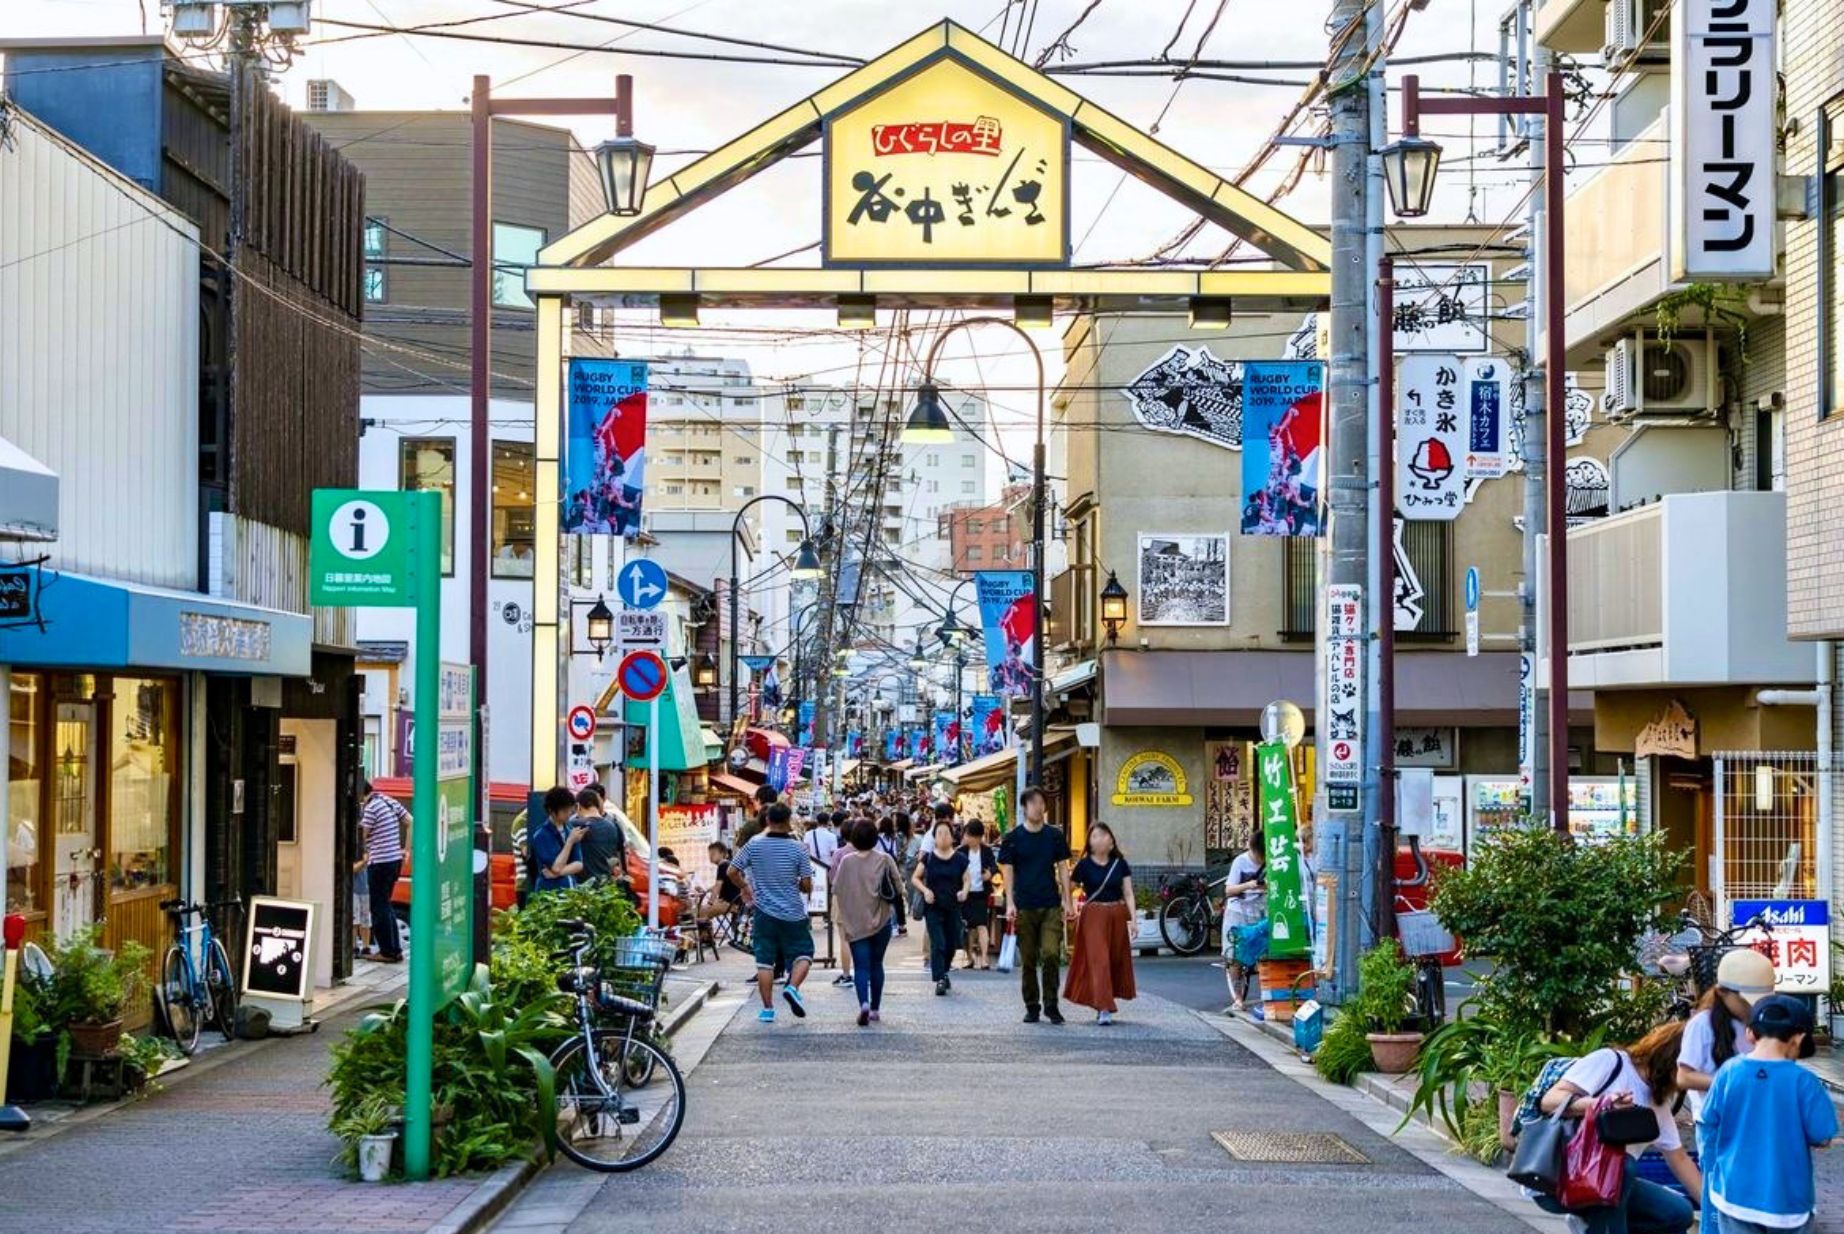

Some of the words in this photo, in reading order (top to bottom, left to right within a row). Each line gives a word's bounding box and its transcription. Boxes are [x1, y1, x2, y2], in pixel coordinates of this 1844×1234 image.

[875, 116, 1001, 156] ひぐらしの里
[846, 148, 1047, 244] 谷中ぎんざ
[574, 372, 612, 382] RUGBY
[1251, 374, 1289, 384] RUGBY
[574, 384, 615, 394] WORLD
[617, 385, 641, 394] CUP
[1250, 385, 1292, 395] WORLD
[1294, 386, 1319, 395] CUP
[1435, 366, 1456, 433] かき氷
[1404, 490, 1458, 507] ひみつ堂
[621, 615, 663, 625] 自転車を除く
[621, 626, 663, 636] 一方通行
[1264, 754, 1289, 872] 竹工芸
[1758, 905, 1805, 924] Asahi
